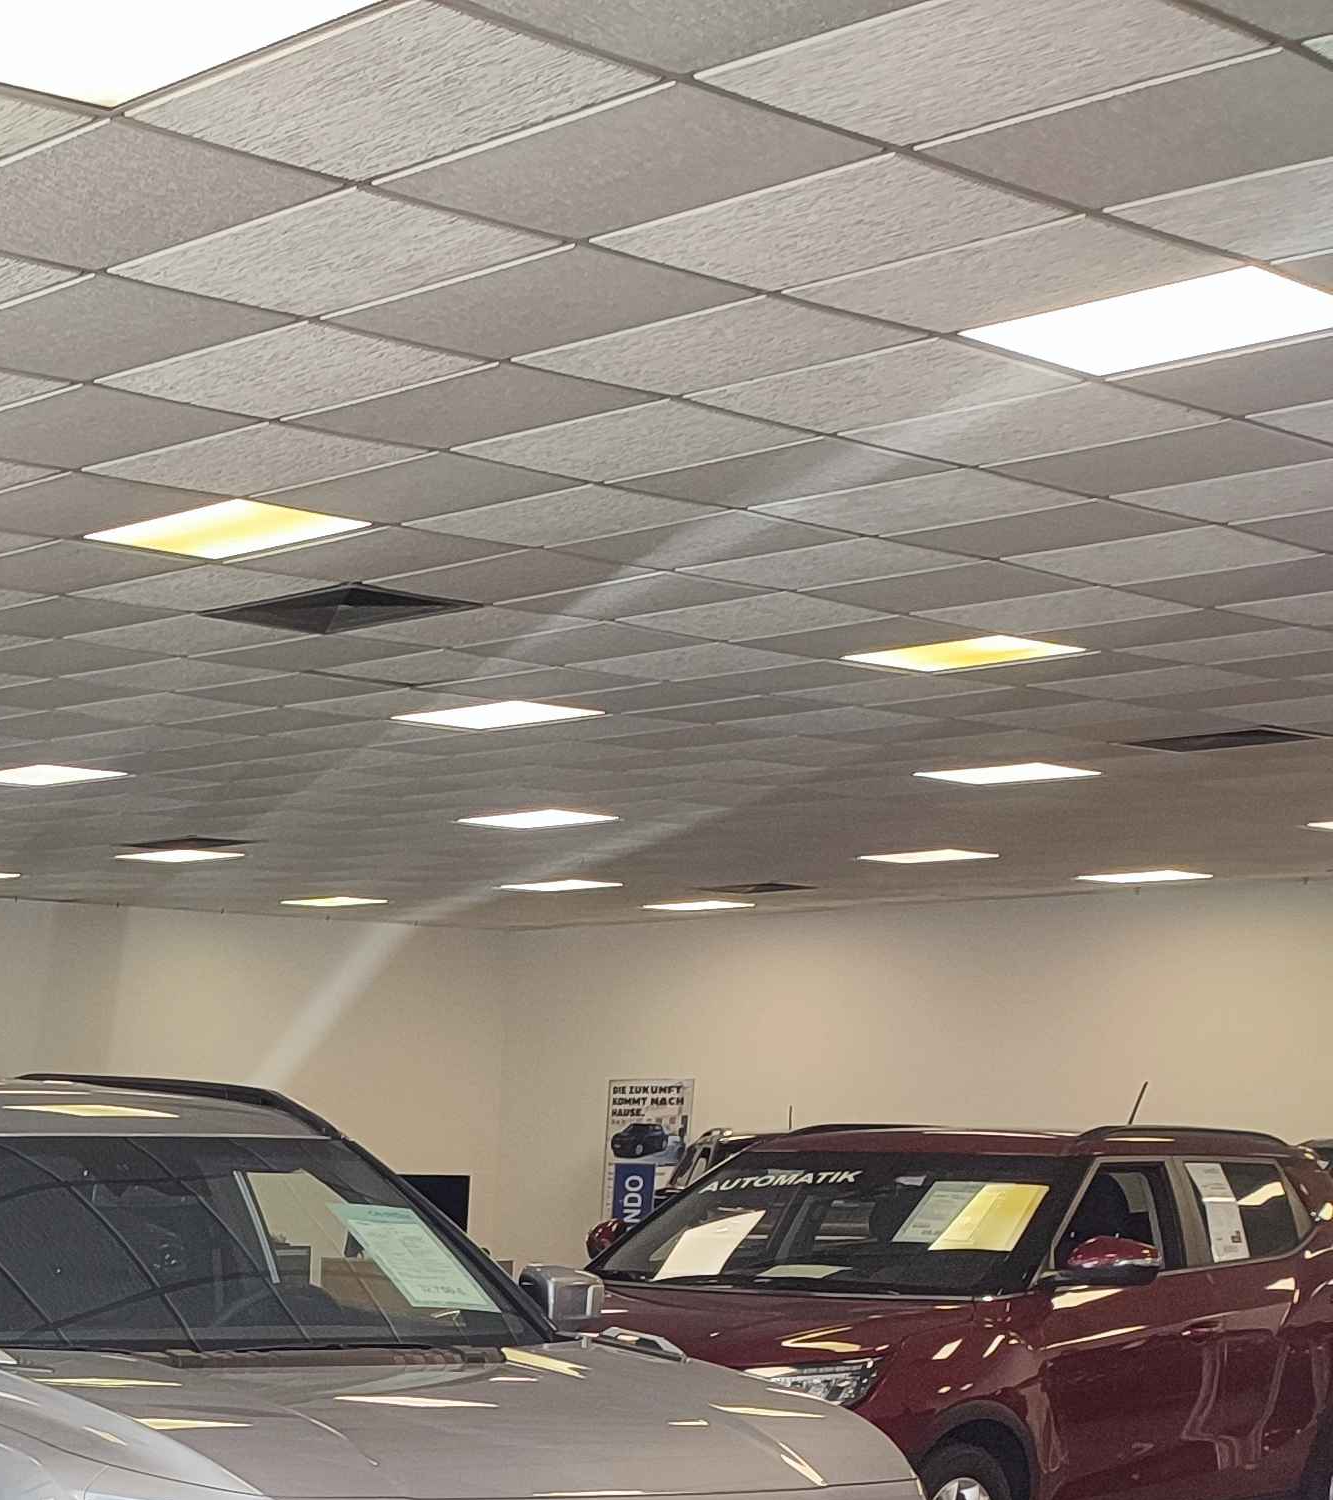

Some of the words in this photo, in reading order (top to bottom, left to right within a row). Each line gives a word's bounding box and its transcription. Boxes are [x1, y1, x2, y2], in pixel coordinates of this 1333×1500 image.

[612, 1097, 648, 1106] KOMMT
[650, 1097, 684, 1106] NACH
[697, 1170, 864, 1194] AUTOMATIK
